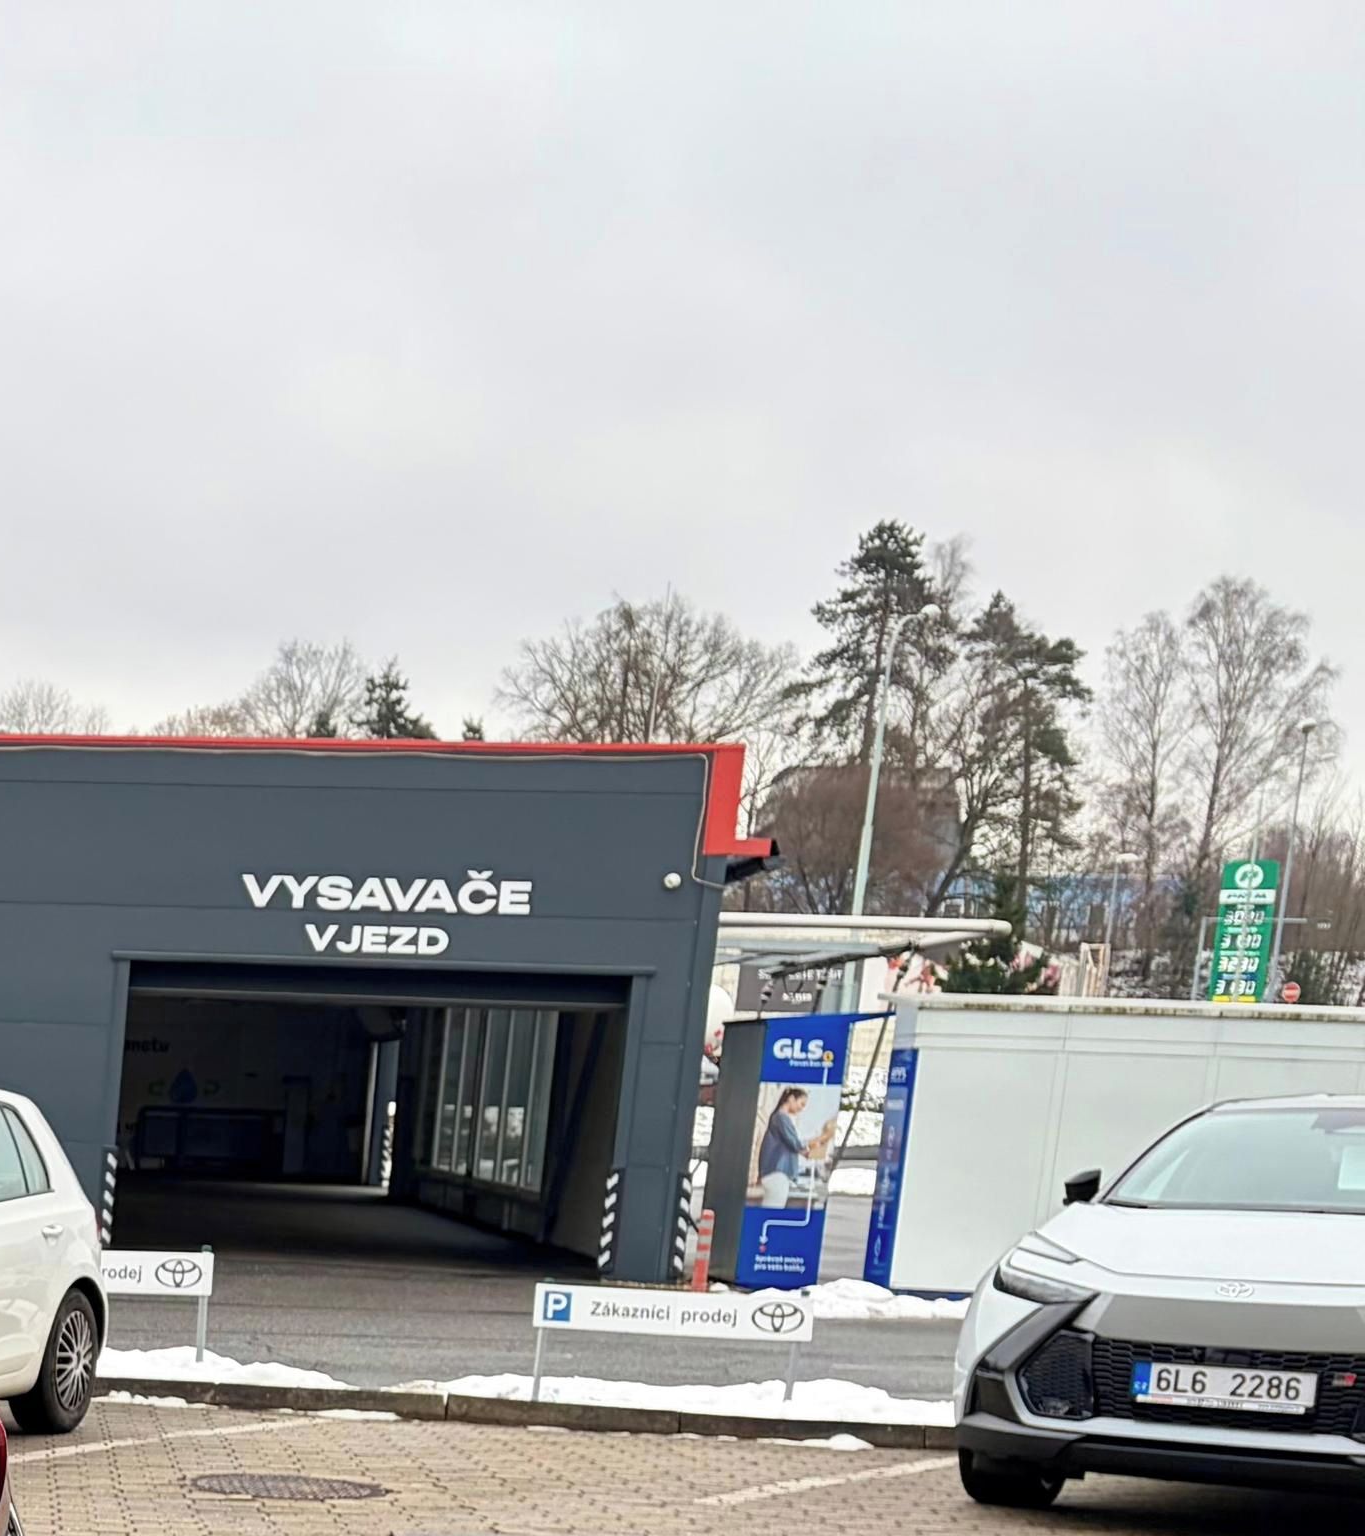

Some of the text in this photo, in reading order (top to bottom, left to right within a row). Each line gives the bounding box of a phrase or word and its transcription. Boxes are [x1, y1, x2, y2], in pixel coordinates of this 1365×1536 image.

[242, 869, 533, 915] VYSAVAČE
[305, 923, 450, 955] VJEZD
[773, 1037, 824, 1060] GLS
[102, 1265, 142, 1283] rodej
[590, 1301, 670, 1321] Zákazníci
[680, 1308, 738, 1328] prodej
[1156, 1368, 1208, 1394] 6L6
[1229, 1373, 1302, 1401] 2286
